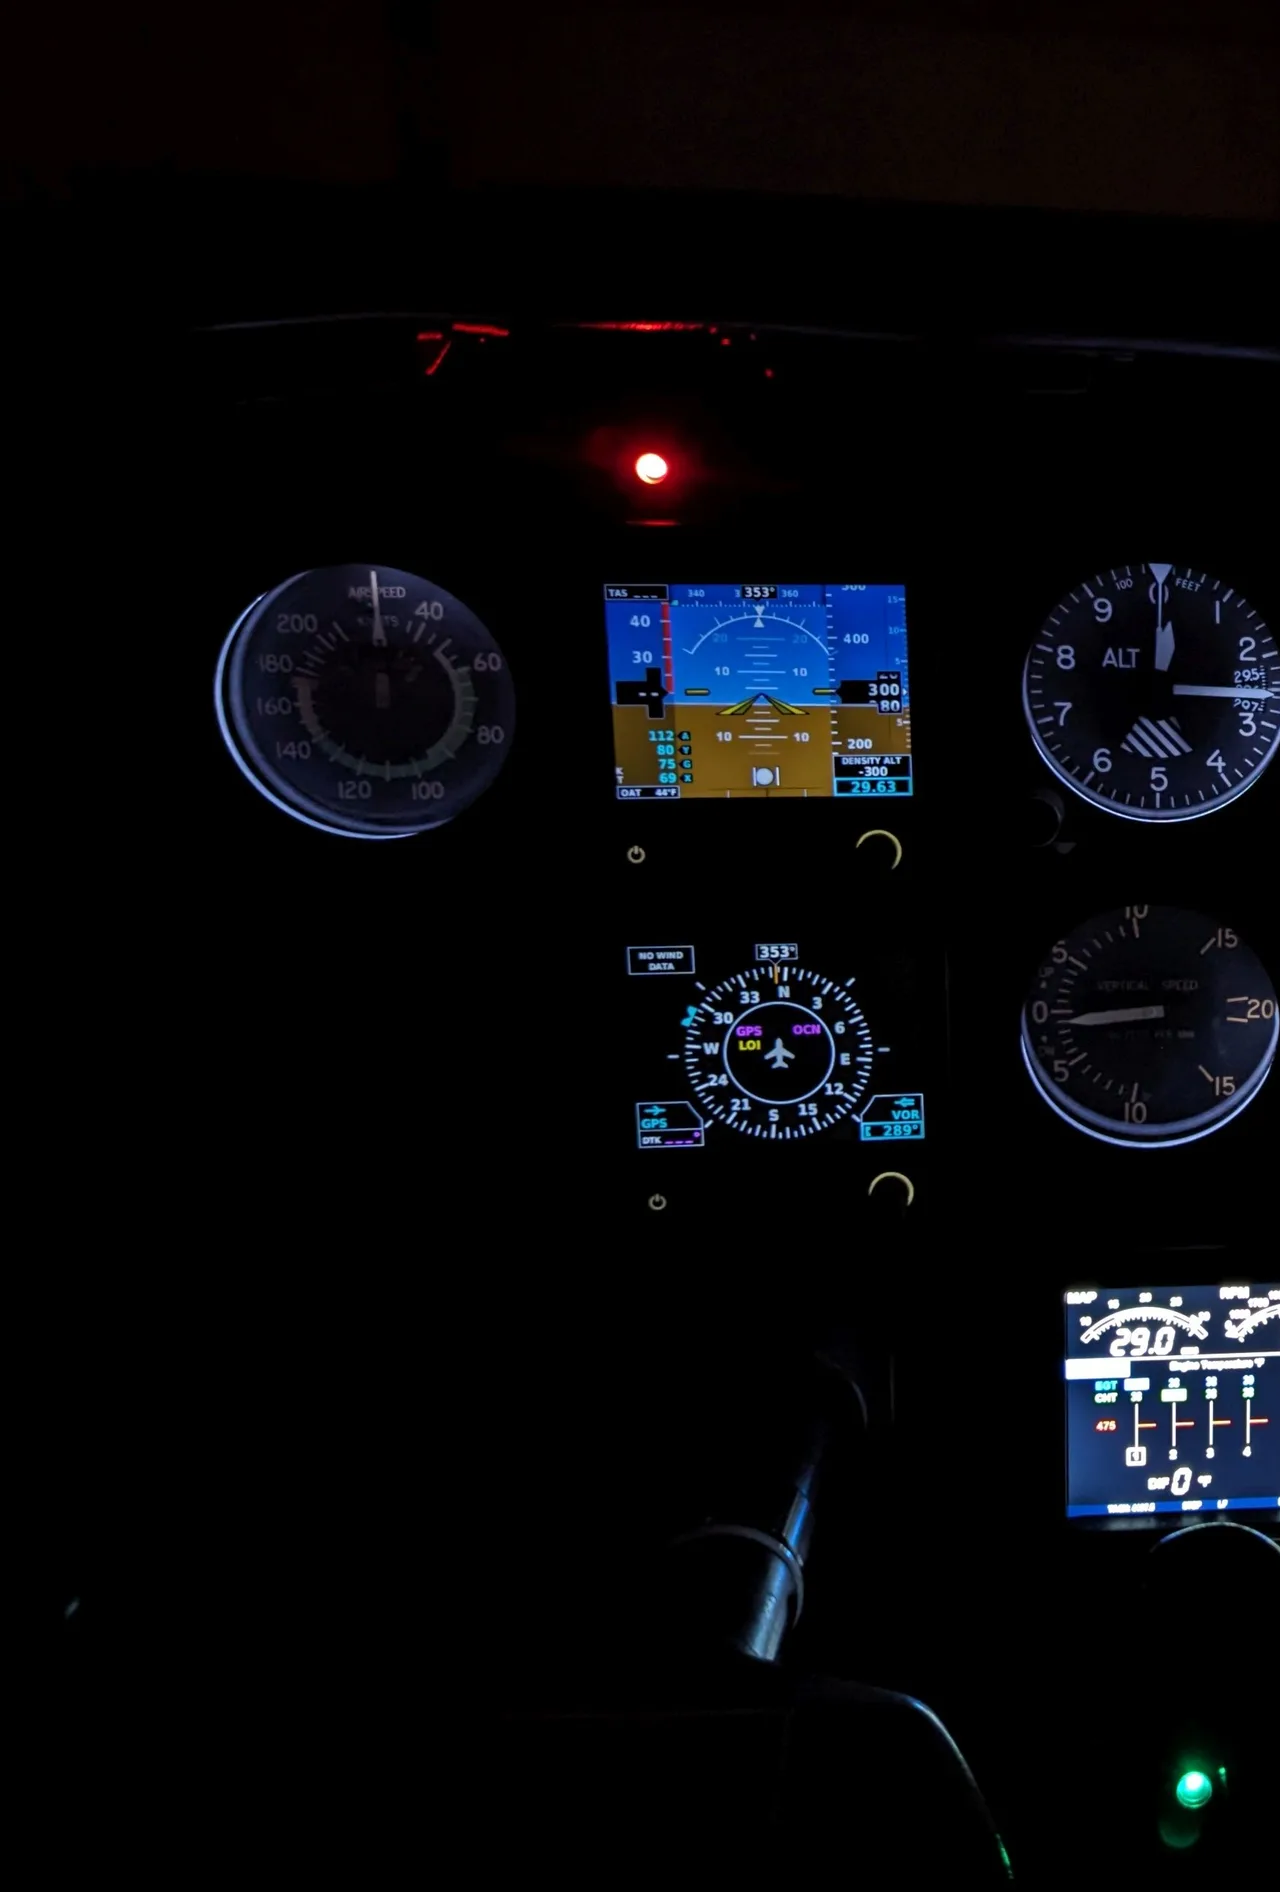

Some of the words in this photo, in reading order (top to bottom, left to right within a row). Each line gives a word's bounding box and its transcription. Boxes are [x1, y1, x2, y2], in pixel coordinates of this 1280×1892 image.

[1115, 578, 1133, 591] 100
[1175, 577, 1201, 592] FEET
[608, 588, 628, 597] TAS
[781, 589, 799, 598] 360
[415, 600, 443, 621] 40
[1093, 598, 1113, 623] 9
[1215, 600, 1220, 624] 1
[276, 614, 318, 633] 200
[630, 614, 651, 628] 40
[843, 633, 870, 645] 400
[1239, 636, 1257, 662] 2
[258, 654, 293, 673] 180
[473, 653, 502, 672] 60
[632, 650, 653, 664] 30
[1056, 645, 1075, 670] 8
[1102, 647, 1140, 669] ALT
[714, 666, 730, 676] 10
[792, 667, 808, 677] 10
[868, 683, 900, 697] 300
[257, 695, 293, 715] 160
[1054, 702, 1073, 727] 7
[1238, 713, 1257, 738] 3
[477, 725, 504, 745] 80
[648, 730, 675, 742] 112
[716, 731, 732, 742] 10
[793, 732, 810, 742] 10
[276, 741, 311, 760] 140
[656, 744, 675, 756] 80
[847, 738, 873, 750] 200
[658, 758, 677, 770] 75
[841, 756, 881, 766] DENSITY
[883, 756, 902, 765] ALT
[1093, 748, 1113, 773] 6
[1206, 749, 1227, 773] 4
[659, 772, 677, 784] 69
[1150, 766, 1169, 791] 5
[338, 780, 373, 800] 120
[412, 780, 445, 801] 100
[620, 788, 642, 797] OAT
[851, 780, 897, 794] 29.63
[1216, 927, 1239, 949] 15
[638, 951, 655, 960] NO
[656, 951, 684, 960] WIND
[1051, 940, 1069, 964] 5
[647, 962, 675, 971] DATA
[739, 990, 760, 1005] 33
[777, 985, 791, 999] N
[811, 996, 823, 1010] 3
[1247, 998, 1274, 1019] 20
[713, 1011, 734, 1025] 30
[1031, 1000, 1049, 1024] 0
[736, 1025, 763, 1037] GPS
[792, 1024, 822, 1036] OCN
[834, 1021, 846, 1034] 6
[702, 1042, 720, 1056] W
[738, 1039, 762, 1051] LOI
[839, 1052, 851, 1066] E
[1053, 1059, 1070, 1083] 5
[707, 1073, 730, 1087] 24
[1214, 1075, 1236, 1096] 15
[824, 1082, 845, 1096] 12
[730, 1098, 752, 1112] 21
[797, 1103, 819, 1117] 15
[1124, 1100, 1148, 1123] 10
[768, 1108, 780, 1122] S
[891, 1109, 920, 1120] VOR
[640, 1118, 668, 1129] GPS
[882, 1124, 919, 1137] 289°
[641, 1136, 663, 1145] DTK
[1110, 1327, 1176, 1357] 29.0
[1096, 1421, 1117, 1431] 475
